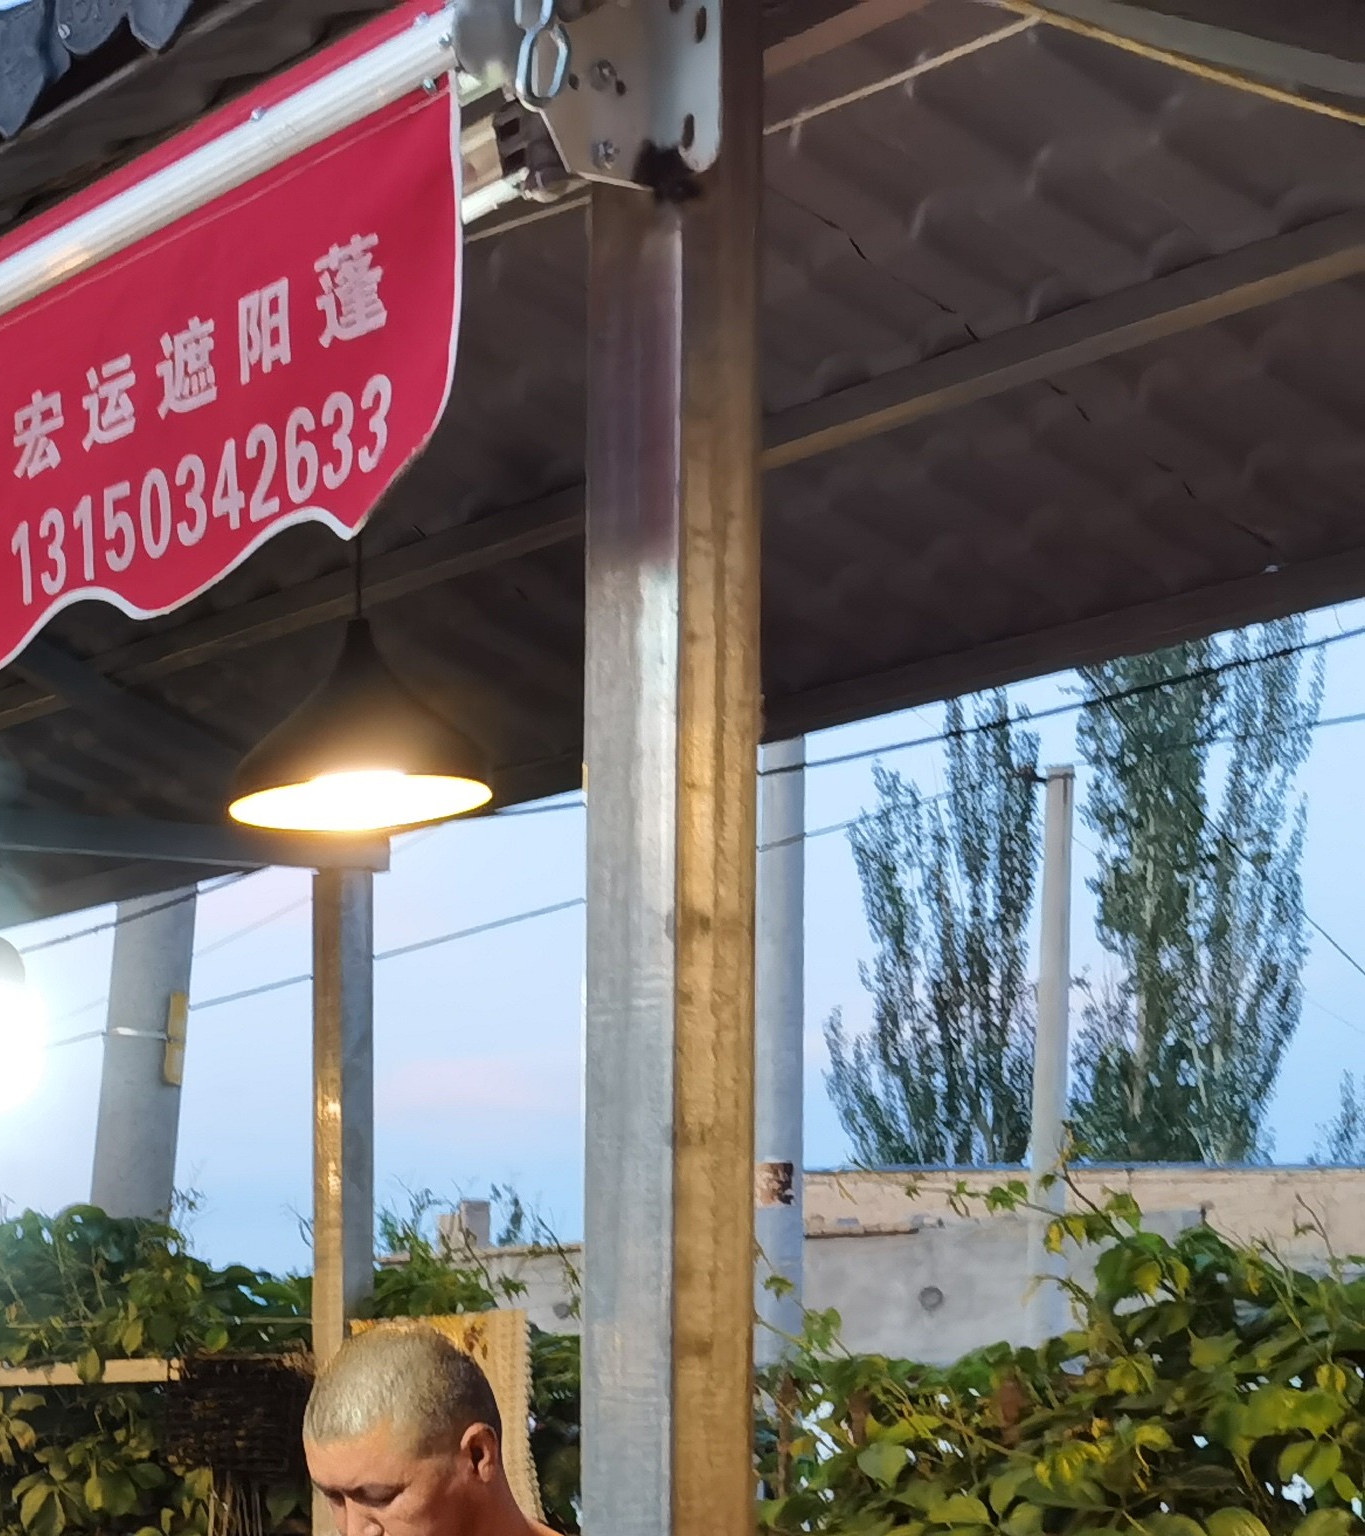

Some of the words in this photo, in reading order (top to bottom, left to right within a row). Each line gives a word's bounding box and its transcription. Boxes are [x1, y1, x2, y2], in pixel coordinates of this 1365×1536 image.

[13, 232, 388, 480] 宏运遮阳蓬
[11, 374, 392, 605] 13150342633
